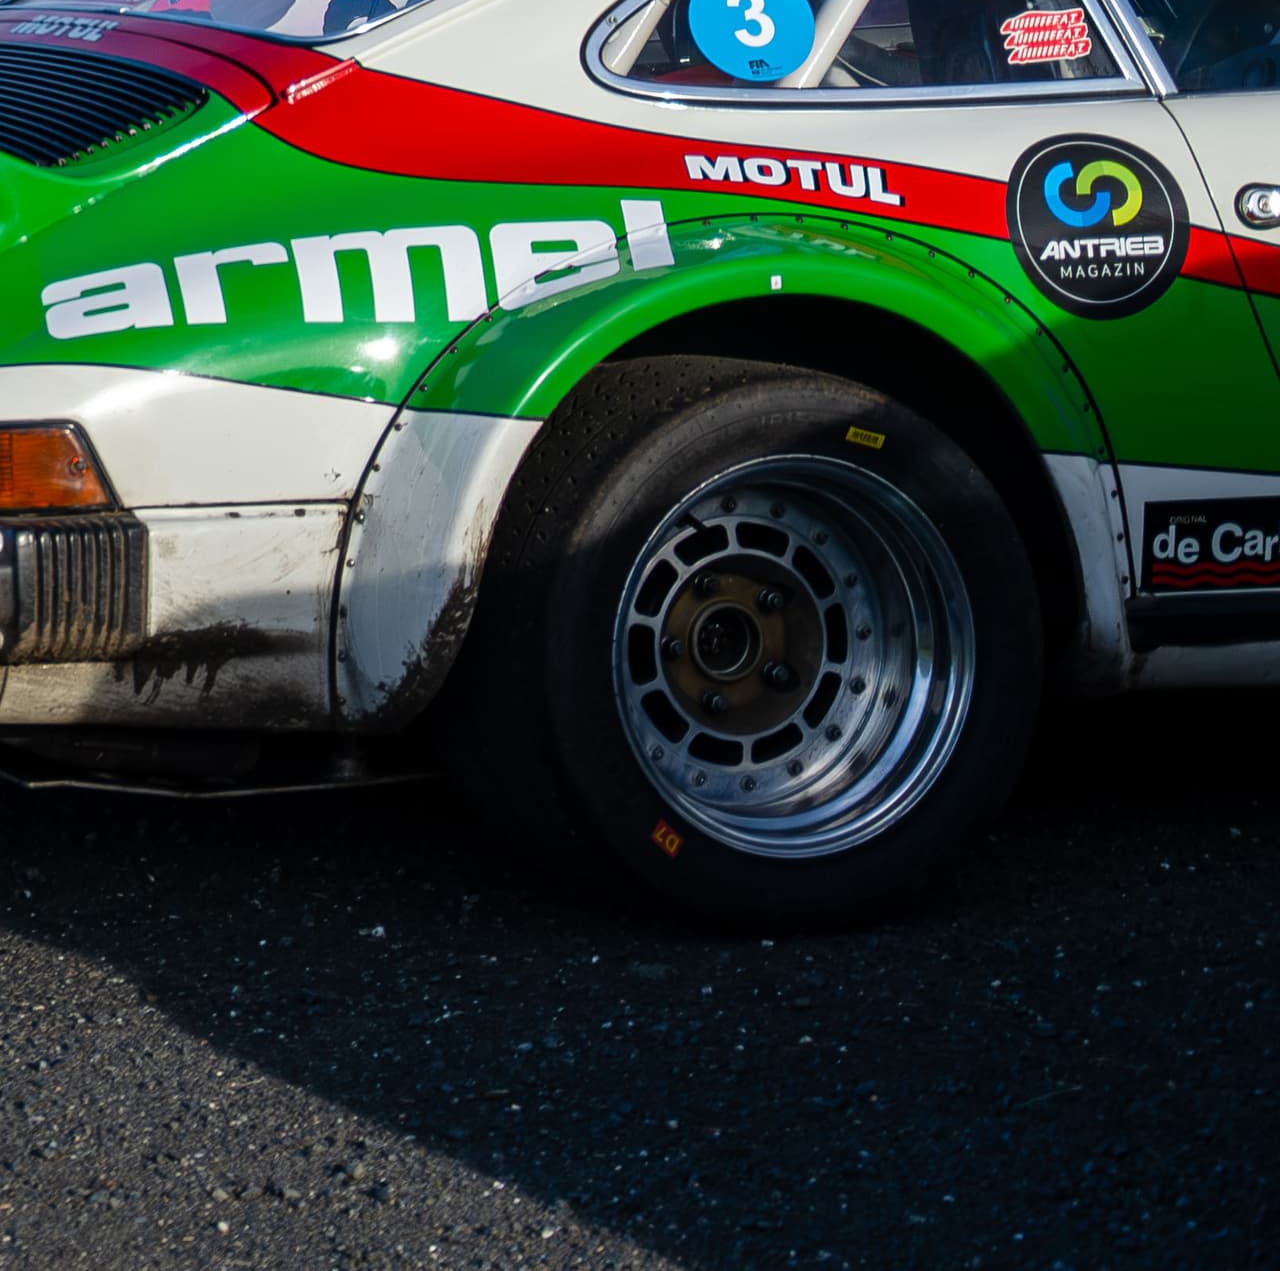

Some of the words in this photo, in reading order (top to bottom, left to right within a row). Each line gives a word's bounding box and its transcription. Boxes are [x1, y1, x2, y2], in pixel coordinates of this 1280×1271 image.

[683, 154, 906, 207] MOTUL
[1040, 234, 1165, 261] ANTRIEB
[40, 198, 676, 340] armel
[1060, 262, 1145, 279] MAGAZIN
[1152, 524, 1200, 564] de
[1210, 522, 1280, 563] Car
